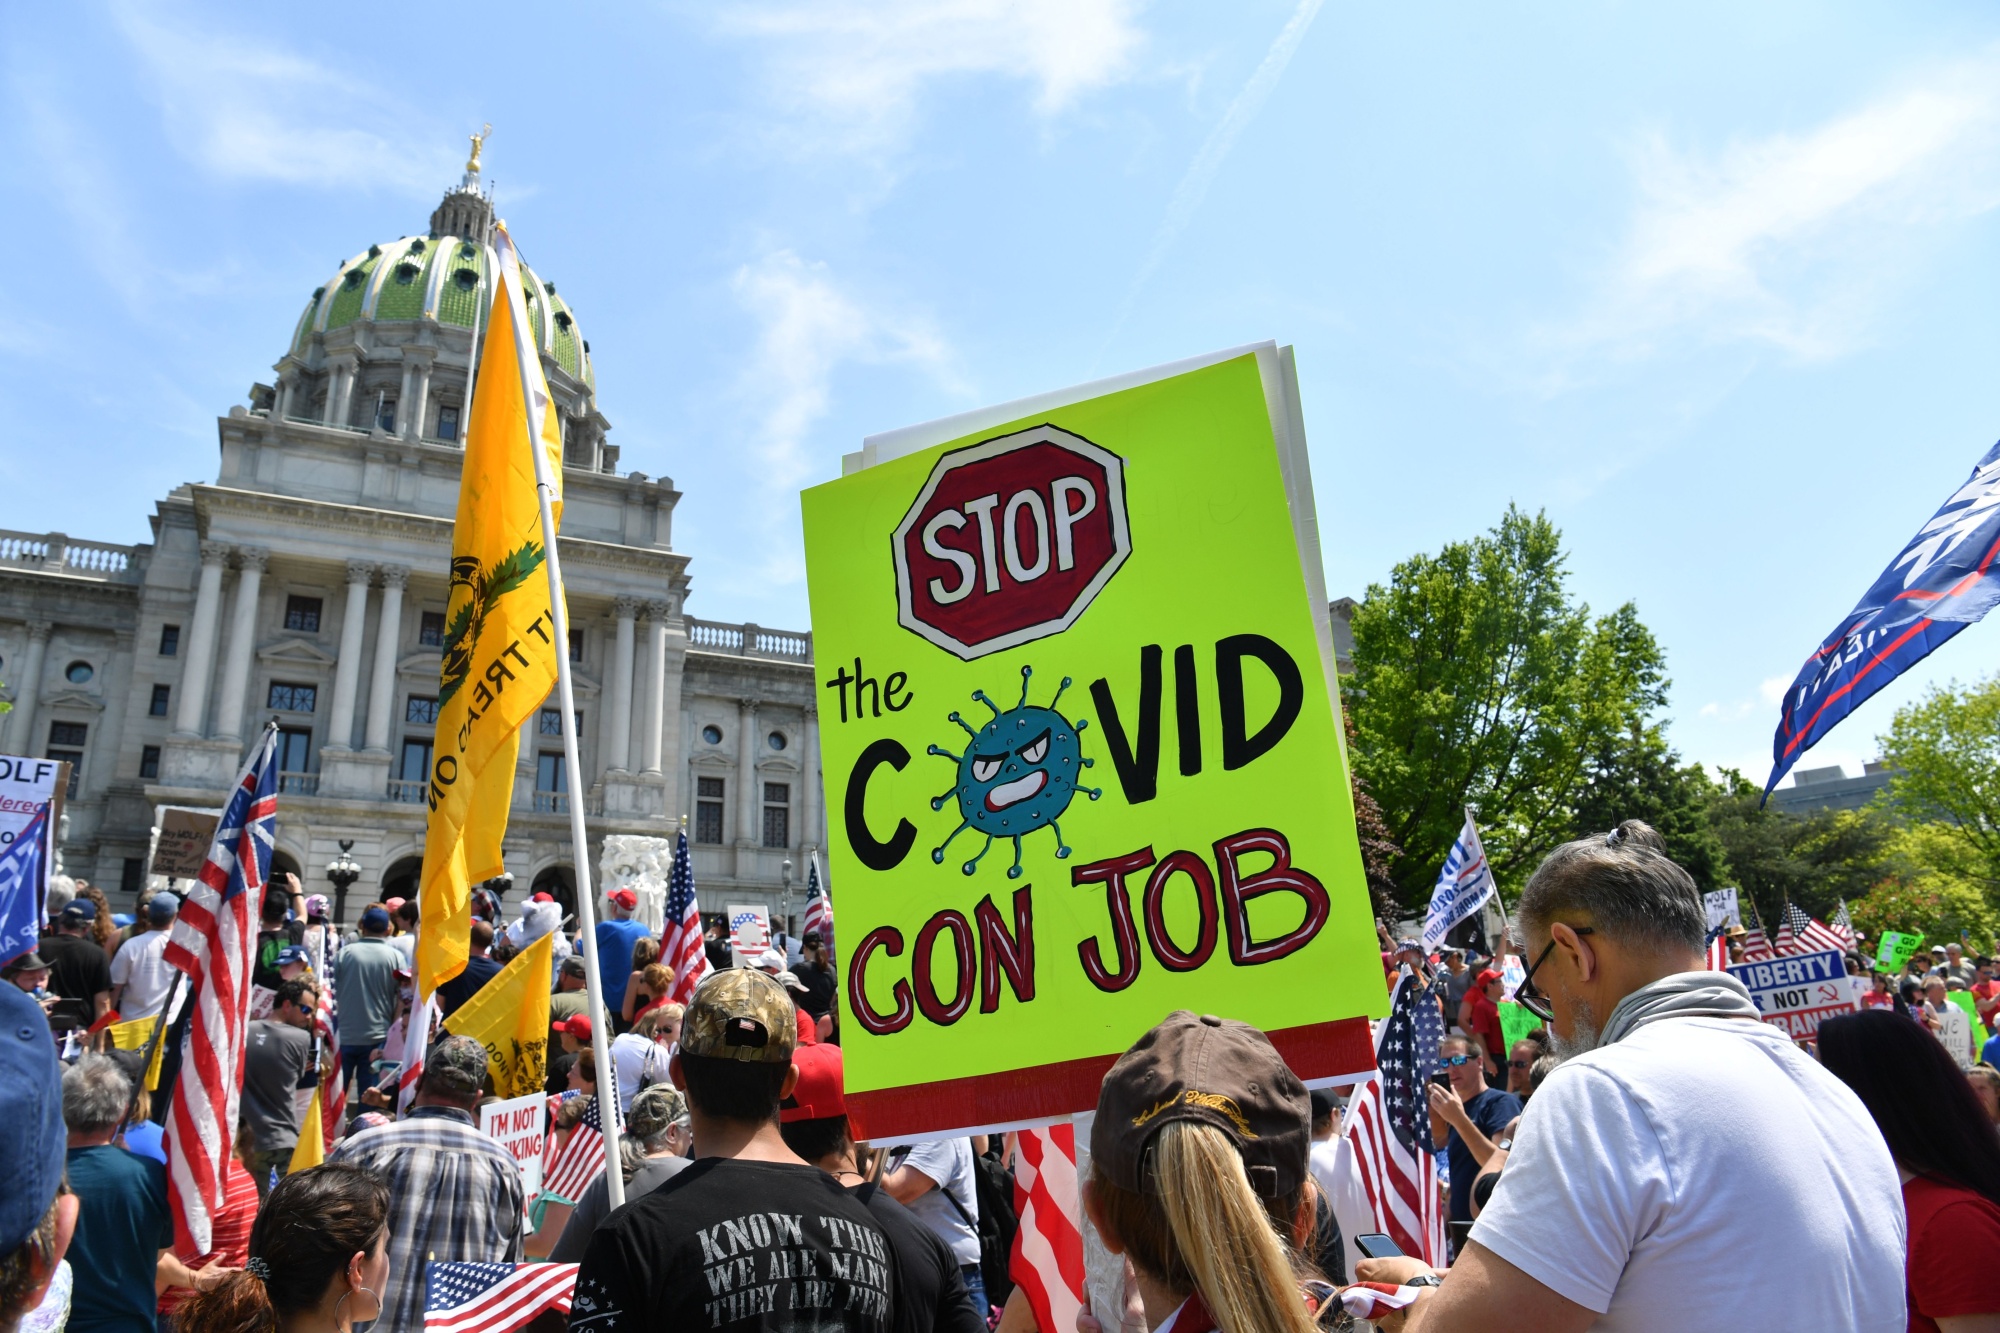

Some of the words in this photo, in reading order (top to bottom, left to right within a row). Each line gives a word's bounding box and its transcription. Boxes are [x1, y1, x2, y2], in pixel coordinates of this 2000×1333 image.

[922, 476, 1096, 605] STOP
[826, 656, 914, 724] the
[0, 758, 53, 784] OLF
[1704, 889, 1732, 904] WOLF
[848, 883, 1036, 1035] CON
[1071, 828, 1332, 993] JOB
[1734, 954, 1832, 991] LIBERTY
[1773, 988, 1809, 1009] NOT
[490, 1112, 509, 1138] I'M
[513, 1105, 537, 1133] NOT
[696, 1212, 803, 1265] KNOW
[819, 1215, 886, 1264] THIS
[704, 1255, 756, 1296] WE
[769, 1249, 817, 1280] ARE
[829, 1252, 888, 1293] MANY
[705, 1284, 778, 1328] THEY
[789, 1280, 836, 1309] ARE
[844, 1284, 889, 1322] FEW
